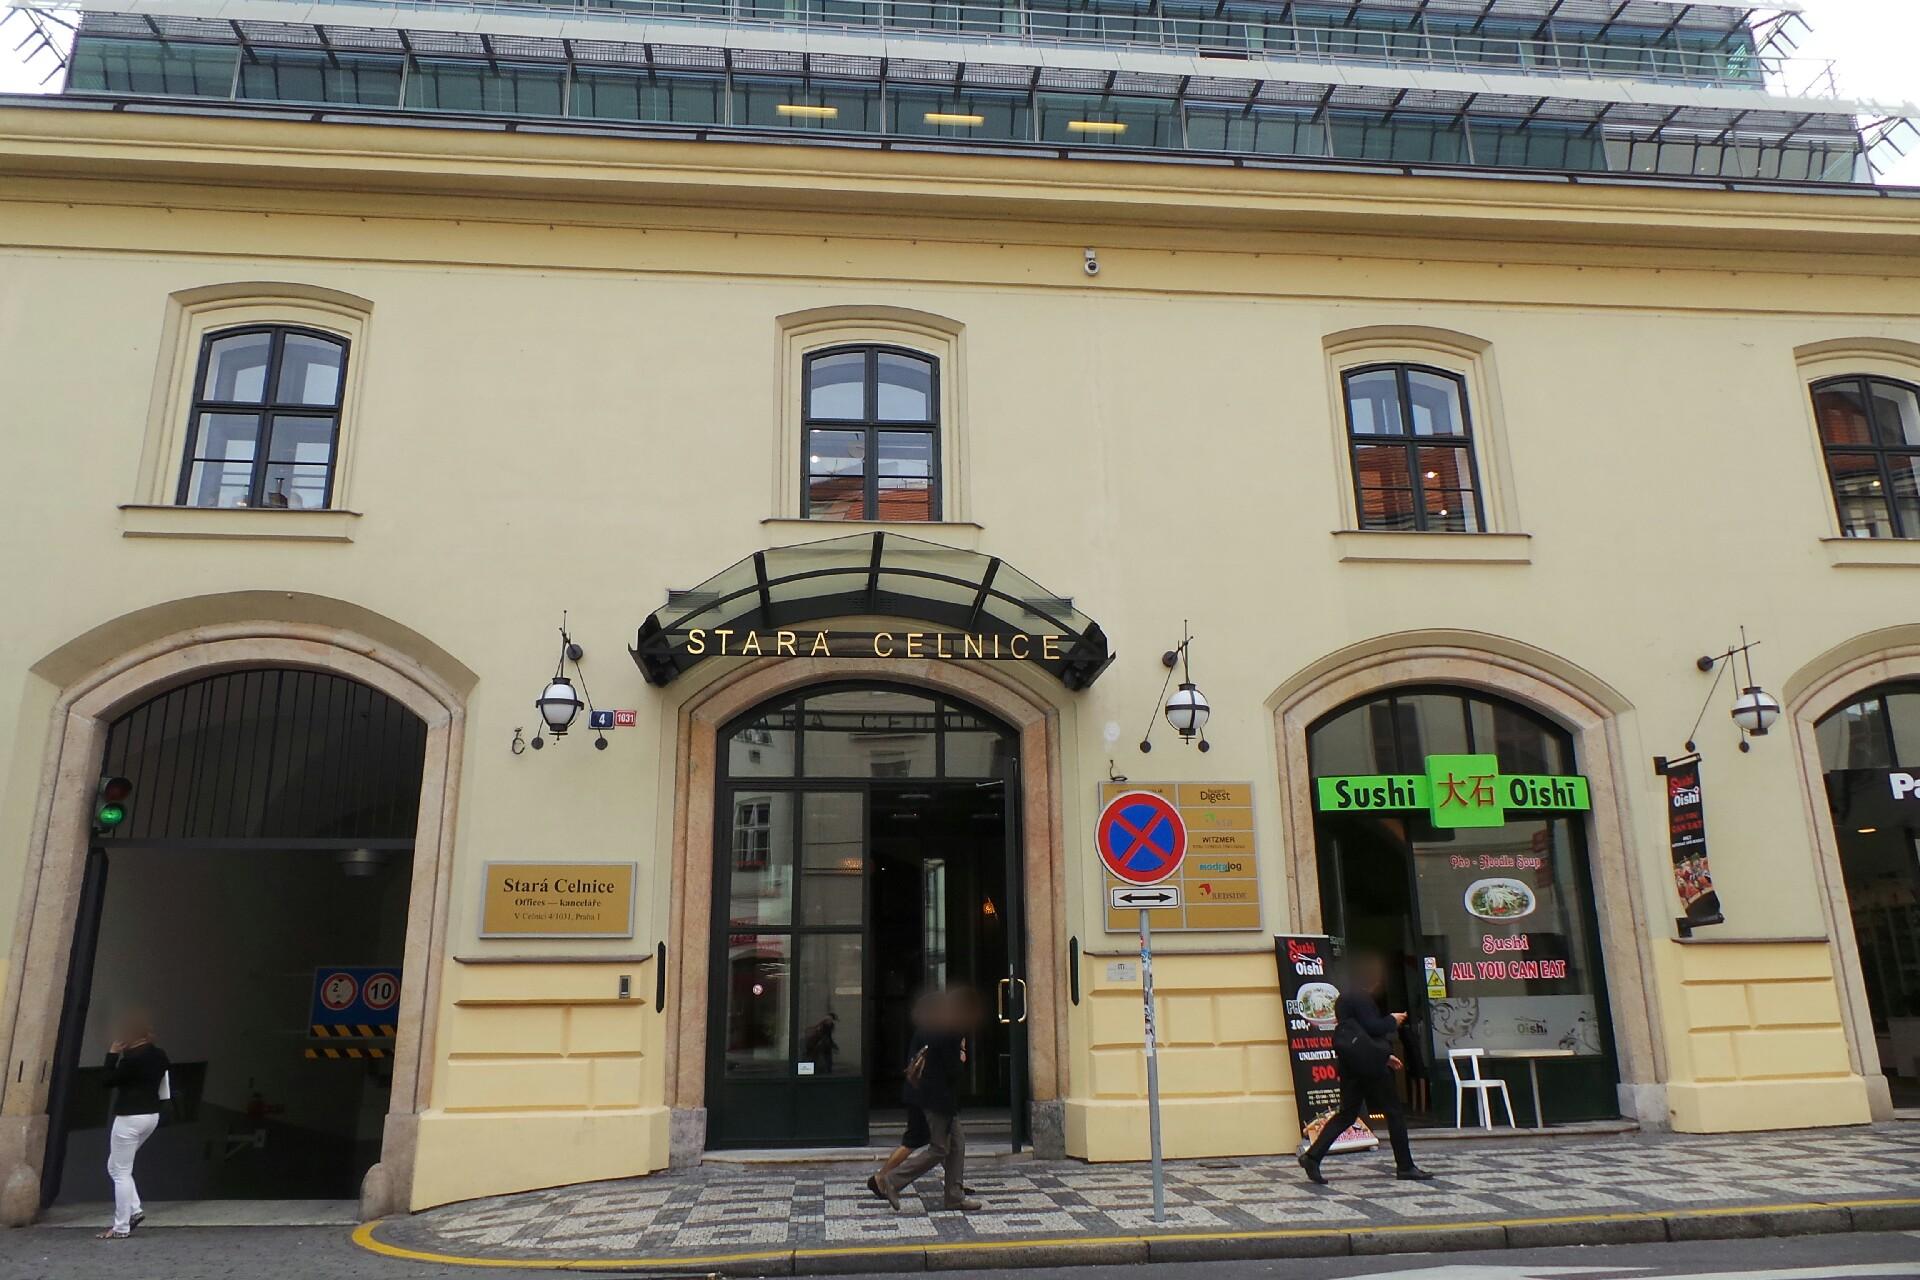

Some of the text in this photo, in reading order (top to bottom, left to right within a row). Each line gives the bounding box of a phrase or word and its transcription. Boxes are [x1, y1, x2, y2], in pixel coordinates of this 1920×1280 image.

[687, 628, 1061, 661] STARÁ CELNICE
[599, 713, 606, 725] 4
[617, 713, 634, 723] 1031
[1200, 791, 1231, 803] Digest
[1335, 778, 1416, 808] Sushi
[1437, 772, 1495, 808] 大石
[1674, 793, 1700, 807] Oishi
[1450, 855, 1470, 868] Pho
[1516, 855, 1541, 869] Soup
[503, 878, 615, 893] Stará Celnice
[1483, 934, 1529, 954] Sushi
[1295, 961, 1324, 976] Oishi
[1451, 960, 1566, 981] ALL YOU CAN EAT
[371, 983, 392, 1000] 10
[1286, 1000, 1305, 1014] PHO
